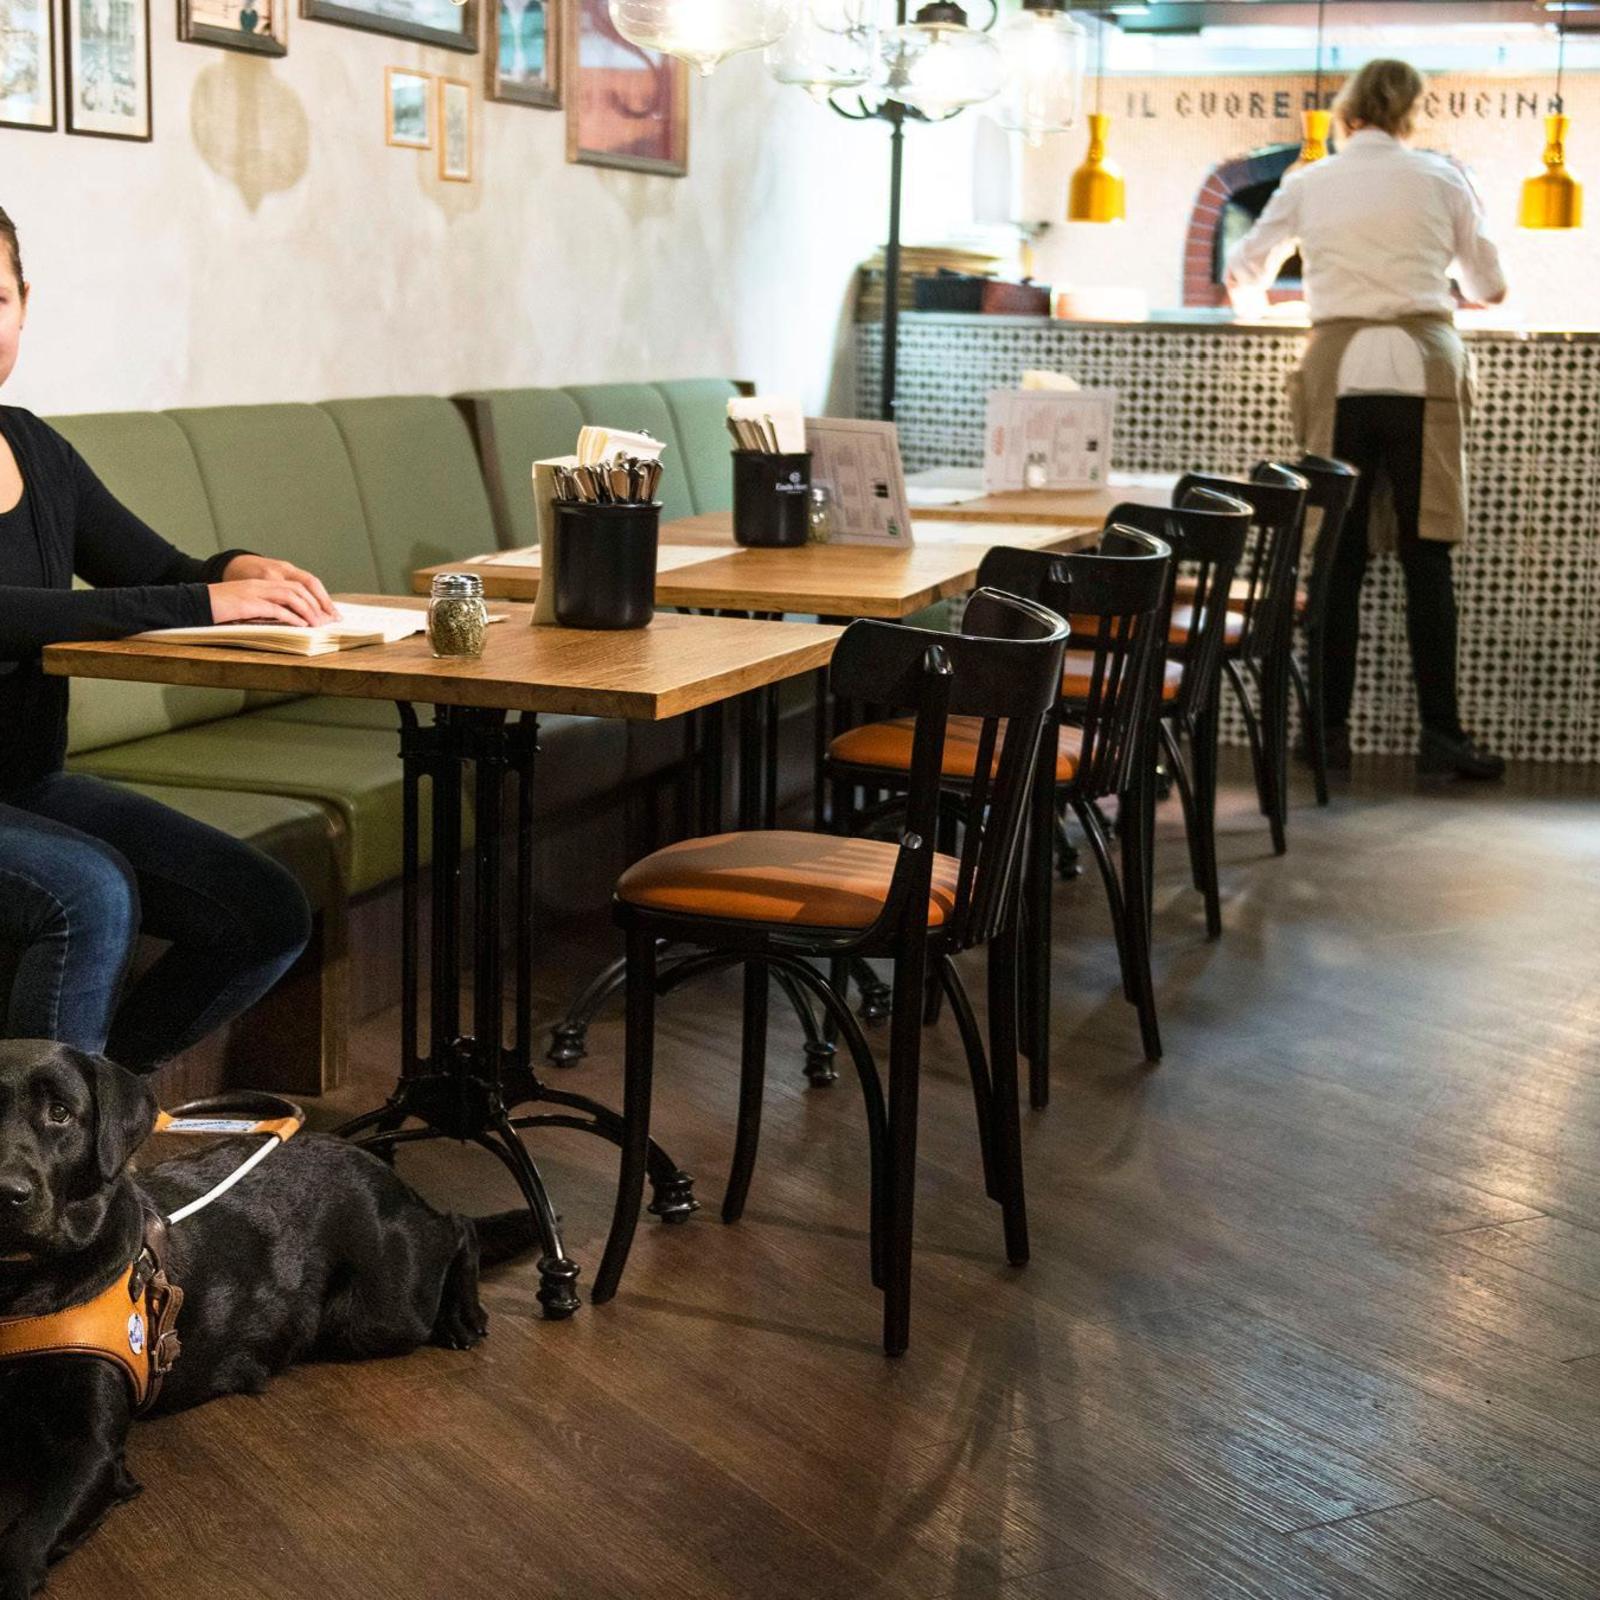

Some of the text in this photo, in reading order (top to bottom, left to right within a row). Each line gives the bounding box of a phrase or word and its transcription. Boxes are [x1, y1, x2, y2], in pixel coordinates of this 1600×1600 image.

[1127, 92, 1156, 118] IL
[1175, 91, 1291, 119] CUORE
[1424, 92, 1563, 118] CUCINA
